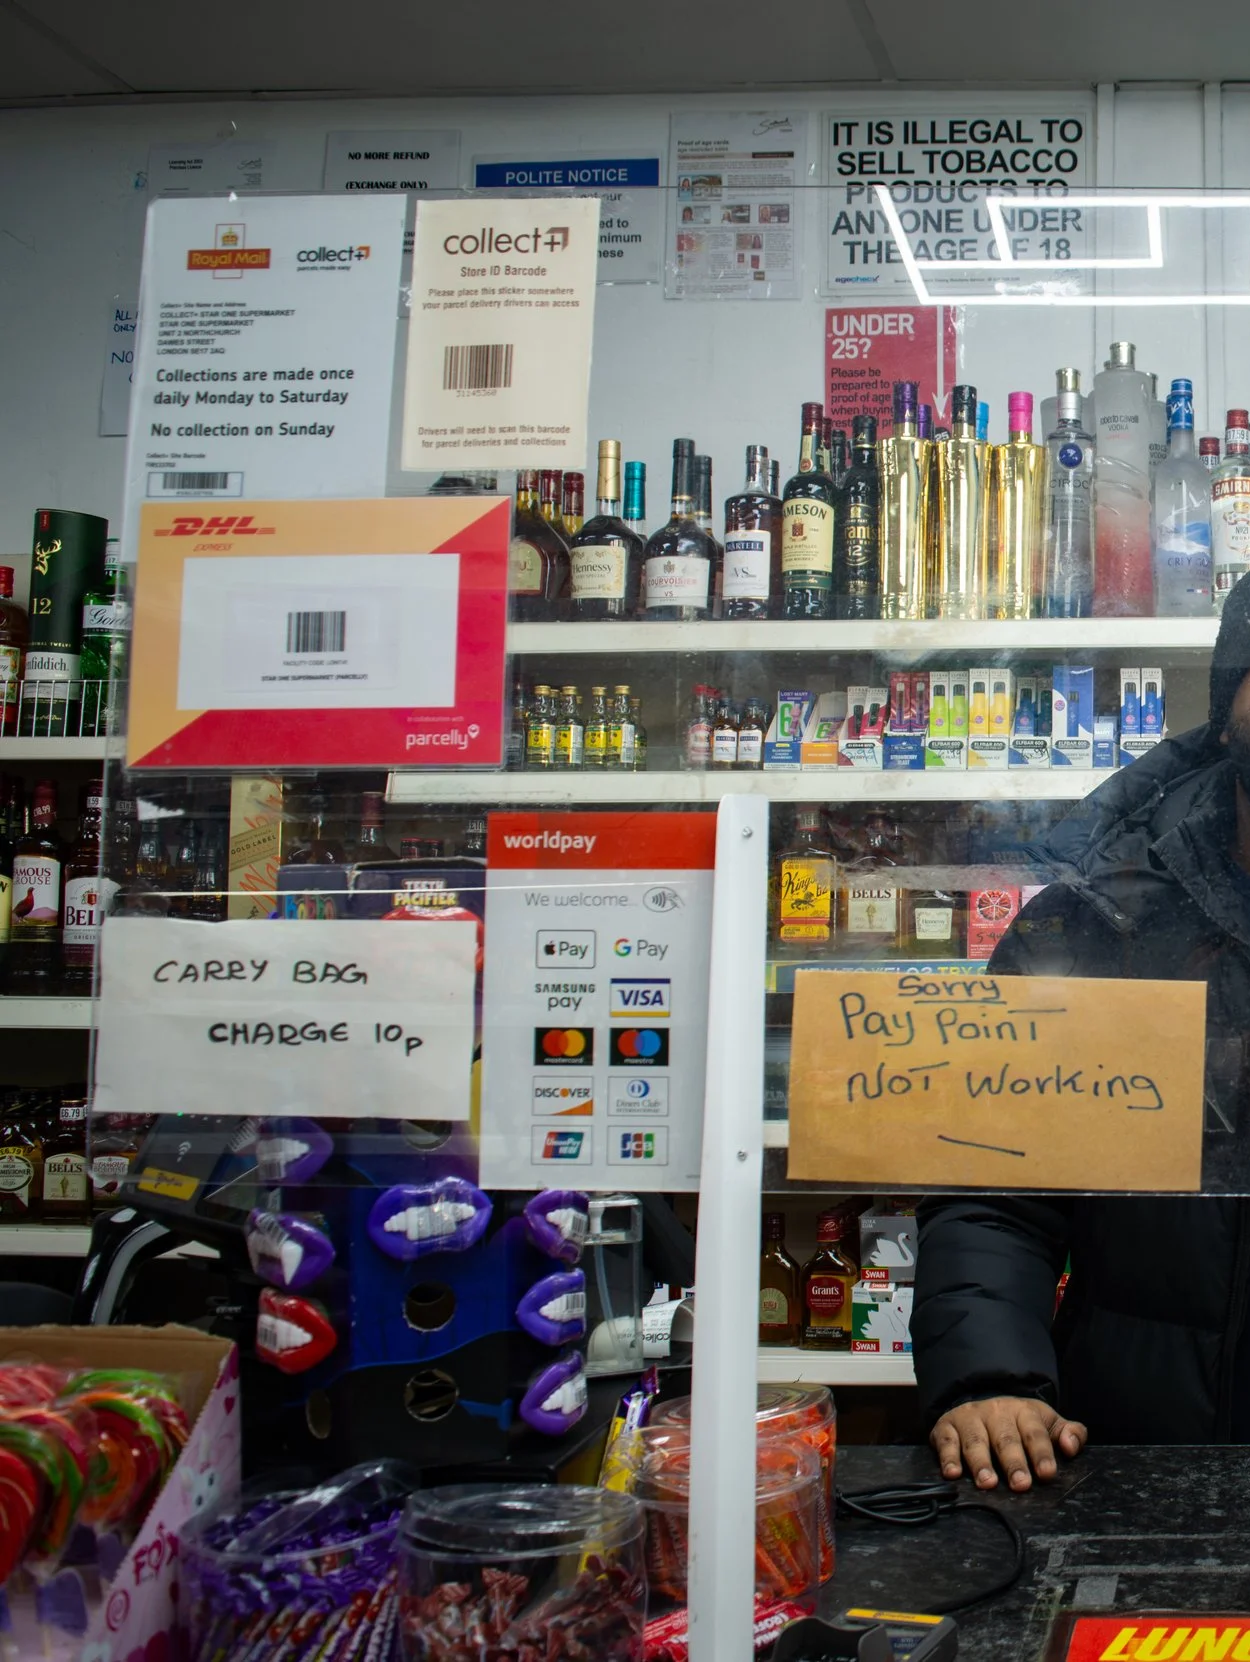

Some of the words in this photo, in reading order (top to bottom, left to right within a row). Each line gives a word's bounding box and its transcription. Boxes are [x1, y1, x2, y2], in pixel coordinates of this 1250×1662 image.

[833, 122, 859, 146] IT
[867, 121, 894, 145] IS
[903, 119, 1033, 144] ILLEGAL
[1040, 119, 1083, 143] TO
[348, 151, 362, 161] NO
[364, 151, 390, 161] MORE
[393, 151, 430, 161] REFUND
[837, 151, 915, 176] SELL
[922, 149, 1078, 174] TOBACCO
[505, 170, 563, 185] POLITE
[568, 168, 628, 184] NOTICE
[345, 181, 398, 190] (EXCHANGE
[400, 181, 428, 190] ONLY)
[1027, 178, 1069, 199] TO
[832, 208, 963, 235] ANYONE
[973, 207, 1083, 233] UNDER
[192, 252, 232, 268] Royal
[234, 250, 268, 265] Mail
[843, 239, 901, 264] THE
[913, 238, 978, 262] AGE
[1039, 238, 1071, 261] 18
[460, 266, 487, 277] Store
[490, 265, 500, 276] ID
[504, 265, 547, 277] Barcode
[428, 288, 455, 297] Please
[457, 288, 479, 297] place
[481, 287, 496, 296] this
[498, 287, 525, 296] sticker
[528, 287, 575, 296] somewhere
[422, 302, 440, 310] your
[443, 301, 468, 310] parcel
[470, 300, 501, 310] delivery
[504, 299, 533, 308] drivers
[552, 300, 579, 308] access
[115, 309, 132, 321] ALL
[832, 313, 915, 336] UNDER
[832, 337, 872, 359] 25?
[156, 368, 238, 382] Collections
[242, 371, 268, 382] are
[273, 367, 314, 381] made
[320, 368, 355, 381] once
[831, 368, 866, 378] Please
[868, 367, 881, 377] be
[831, 380, 878, 392] prepared
[880, 380, 890, 389] to
[154, 391, 190, 407] daily
[195, 390, 254, 407] Monday
[259, 391, 274, 404] to
[279, 389, 349, 406] Saturday
[831, 393, 858, 404] proof
[860, 392, 870, 402] of
[872, 393, 891, 404] age
[831, 405, 860, 416] when
[151, 424, 172, 437] No
[177, 422, 249, 437] collection
[254, 425, 273, 437] on
[279, 422, 335, 439] Sunday
[418, 426, 447, 436] Drivers
[450, 426, 464, 435] will
[467, 426, 486, 435] need
[488, 426, 496, 435] to
[498, 427, 516, 435] scan
[519, 425, 535, 434] this
[537, 424, 570, 435] barcode
[422, 440, 433, 449] for
[435, 439, 460, 450] parcel
[463, 438, 501, 448] deliveries
[503, 438, 518, 447] and
[521, 438, 566, 447] collections
[169, 516, 259, 536] DHL
[193, 543, 234, 552] EXPRESS
[573, 561, 612, 574] Hennessy
[32, 598, 51, 615] 12
[406, 729, 469, 750] parcelly
[504, 831, 596, 853] worldpay
[394, 891, 458, 906] PACIFIER
[525, 891, 550, 907] We
[559, 941, 588, 959] Pay
[637, 939, 669, 961] Pay
[153, 959, 269, 985] CARRY
[292, 960, 368, 986] BAG
[535, 983, 596, 993] SAMSUNG
[897, 974, 1003, 1001] Sorry
[547, 996, 583, 1012] pay
[617, 989, 665, 1006] VISA
[841, 992, 914, 1047] Pay
[208, 1022, 349, 1046] CHARGE
[535, 1087, 591, 1098] DISCOVER
[966, 1065, 1164, 1110] Working
[50, 1163, 83, 1173] BELL'S
[865, 1269, 886, 1279] SWAN
[812, 1285, 840, 1295] Grant's
[855, 1341, 877, 1351] SWAN
